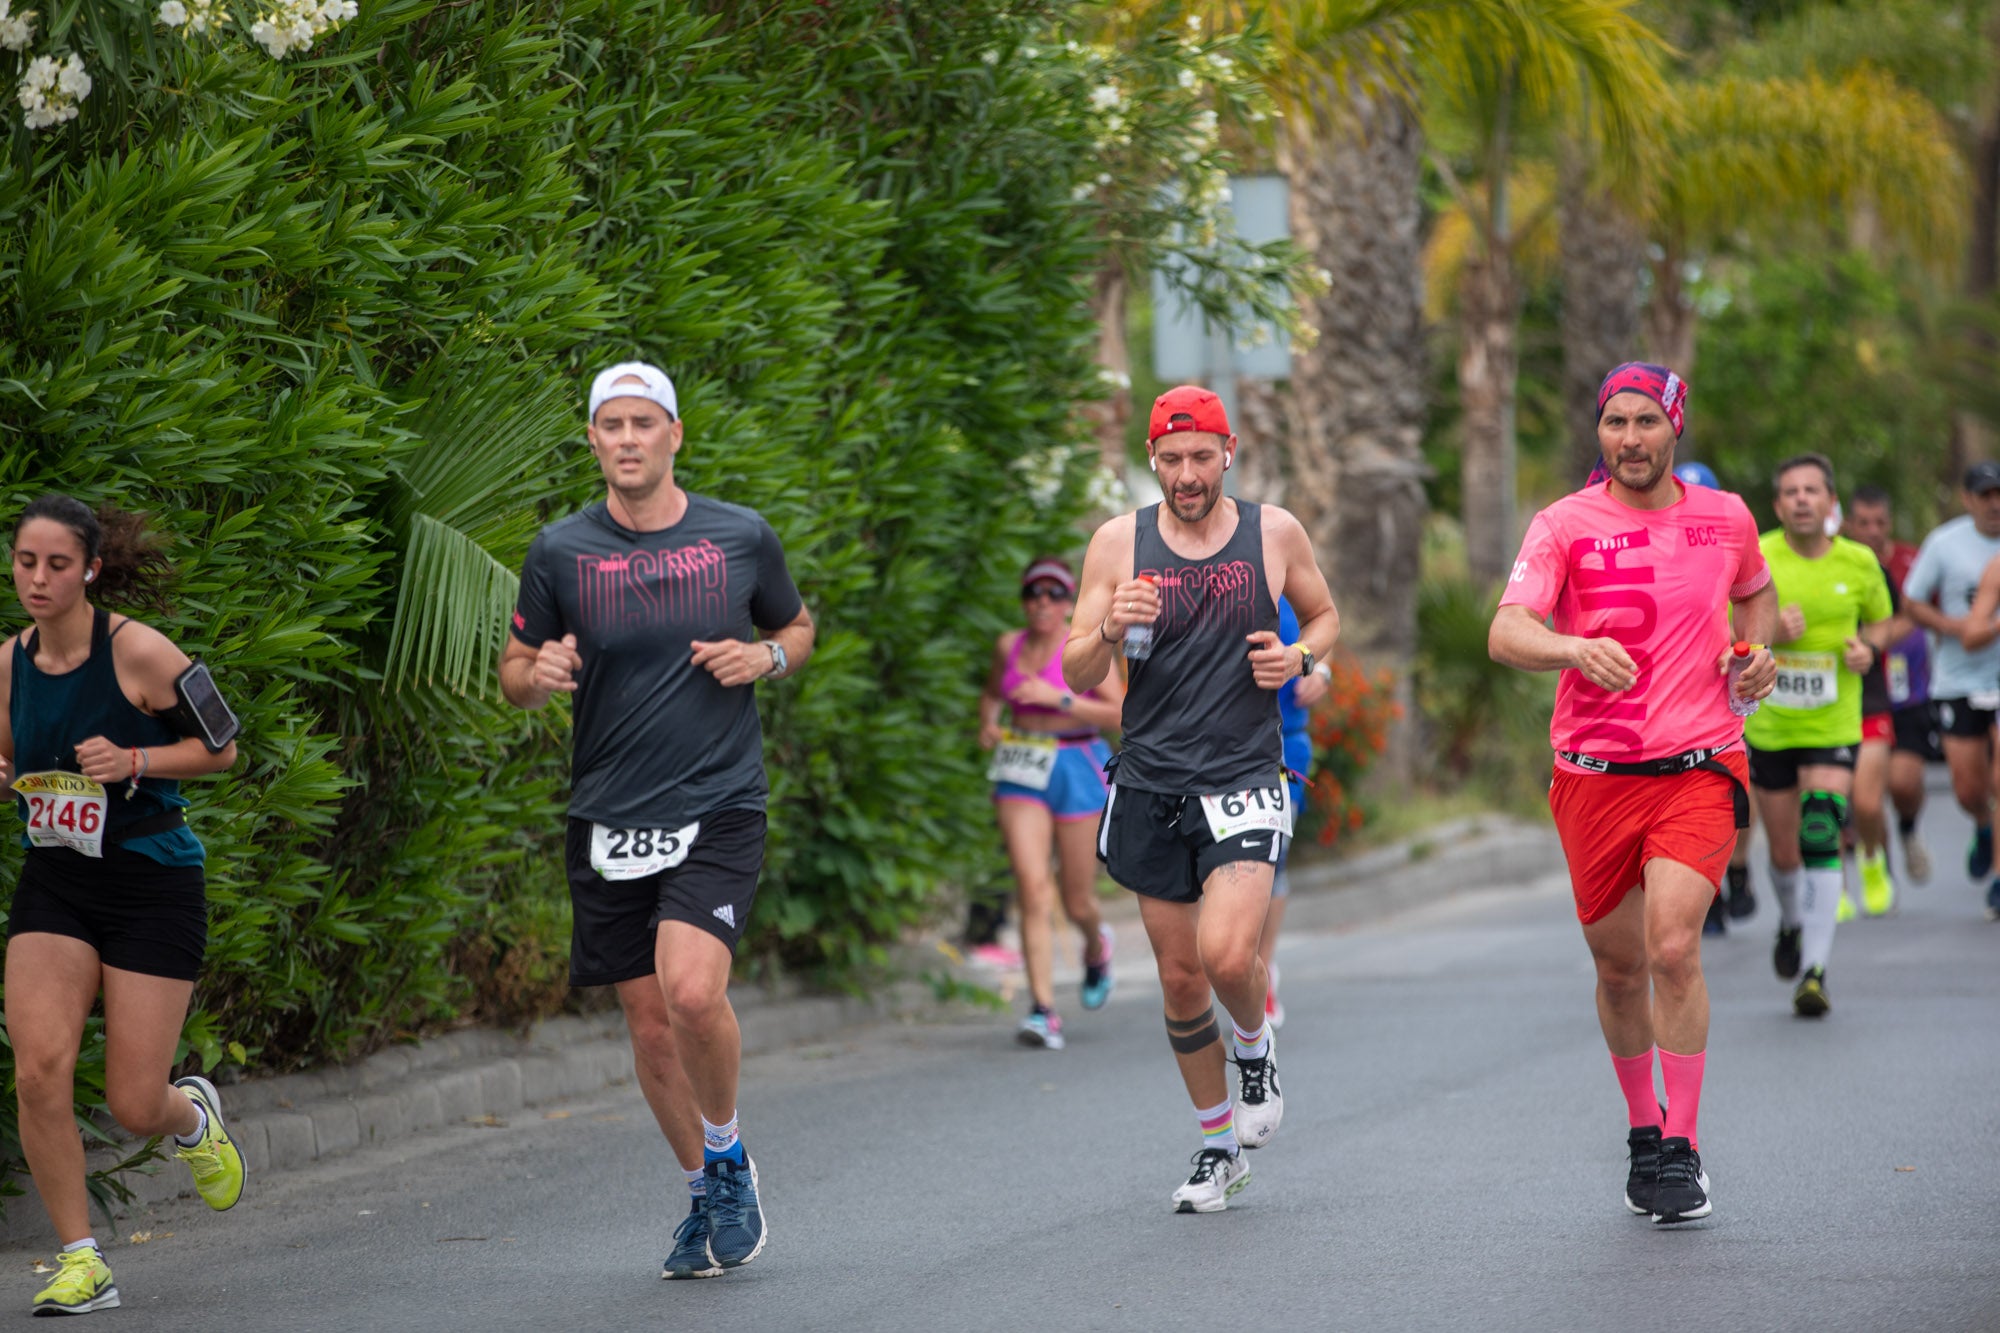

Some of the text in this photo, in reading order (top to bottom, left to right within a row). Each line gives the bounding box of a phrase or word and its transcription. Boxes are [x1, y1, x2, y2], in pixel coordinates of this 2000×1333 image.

[1685, 526, 1718, 547] BCC
[29, 796, 101, 834] 2146
[1221, 787, 1284, 817] 619
[606, 828, 680, 860] 285
